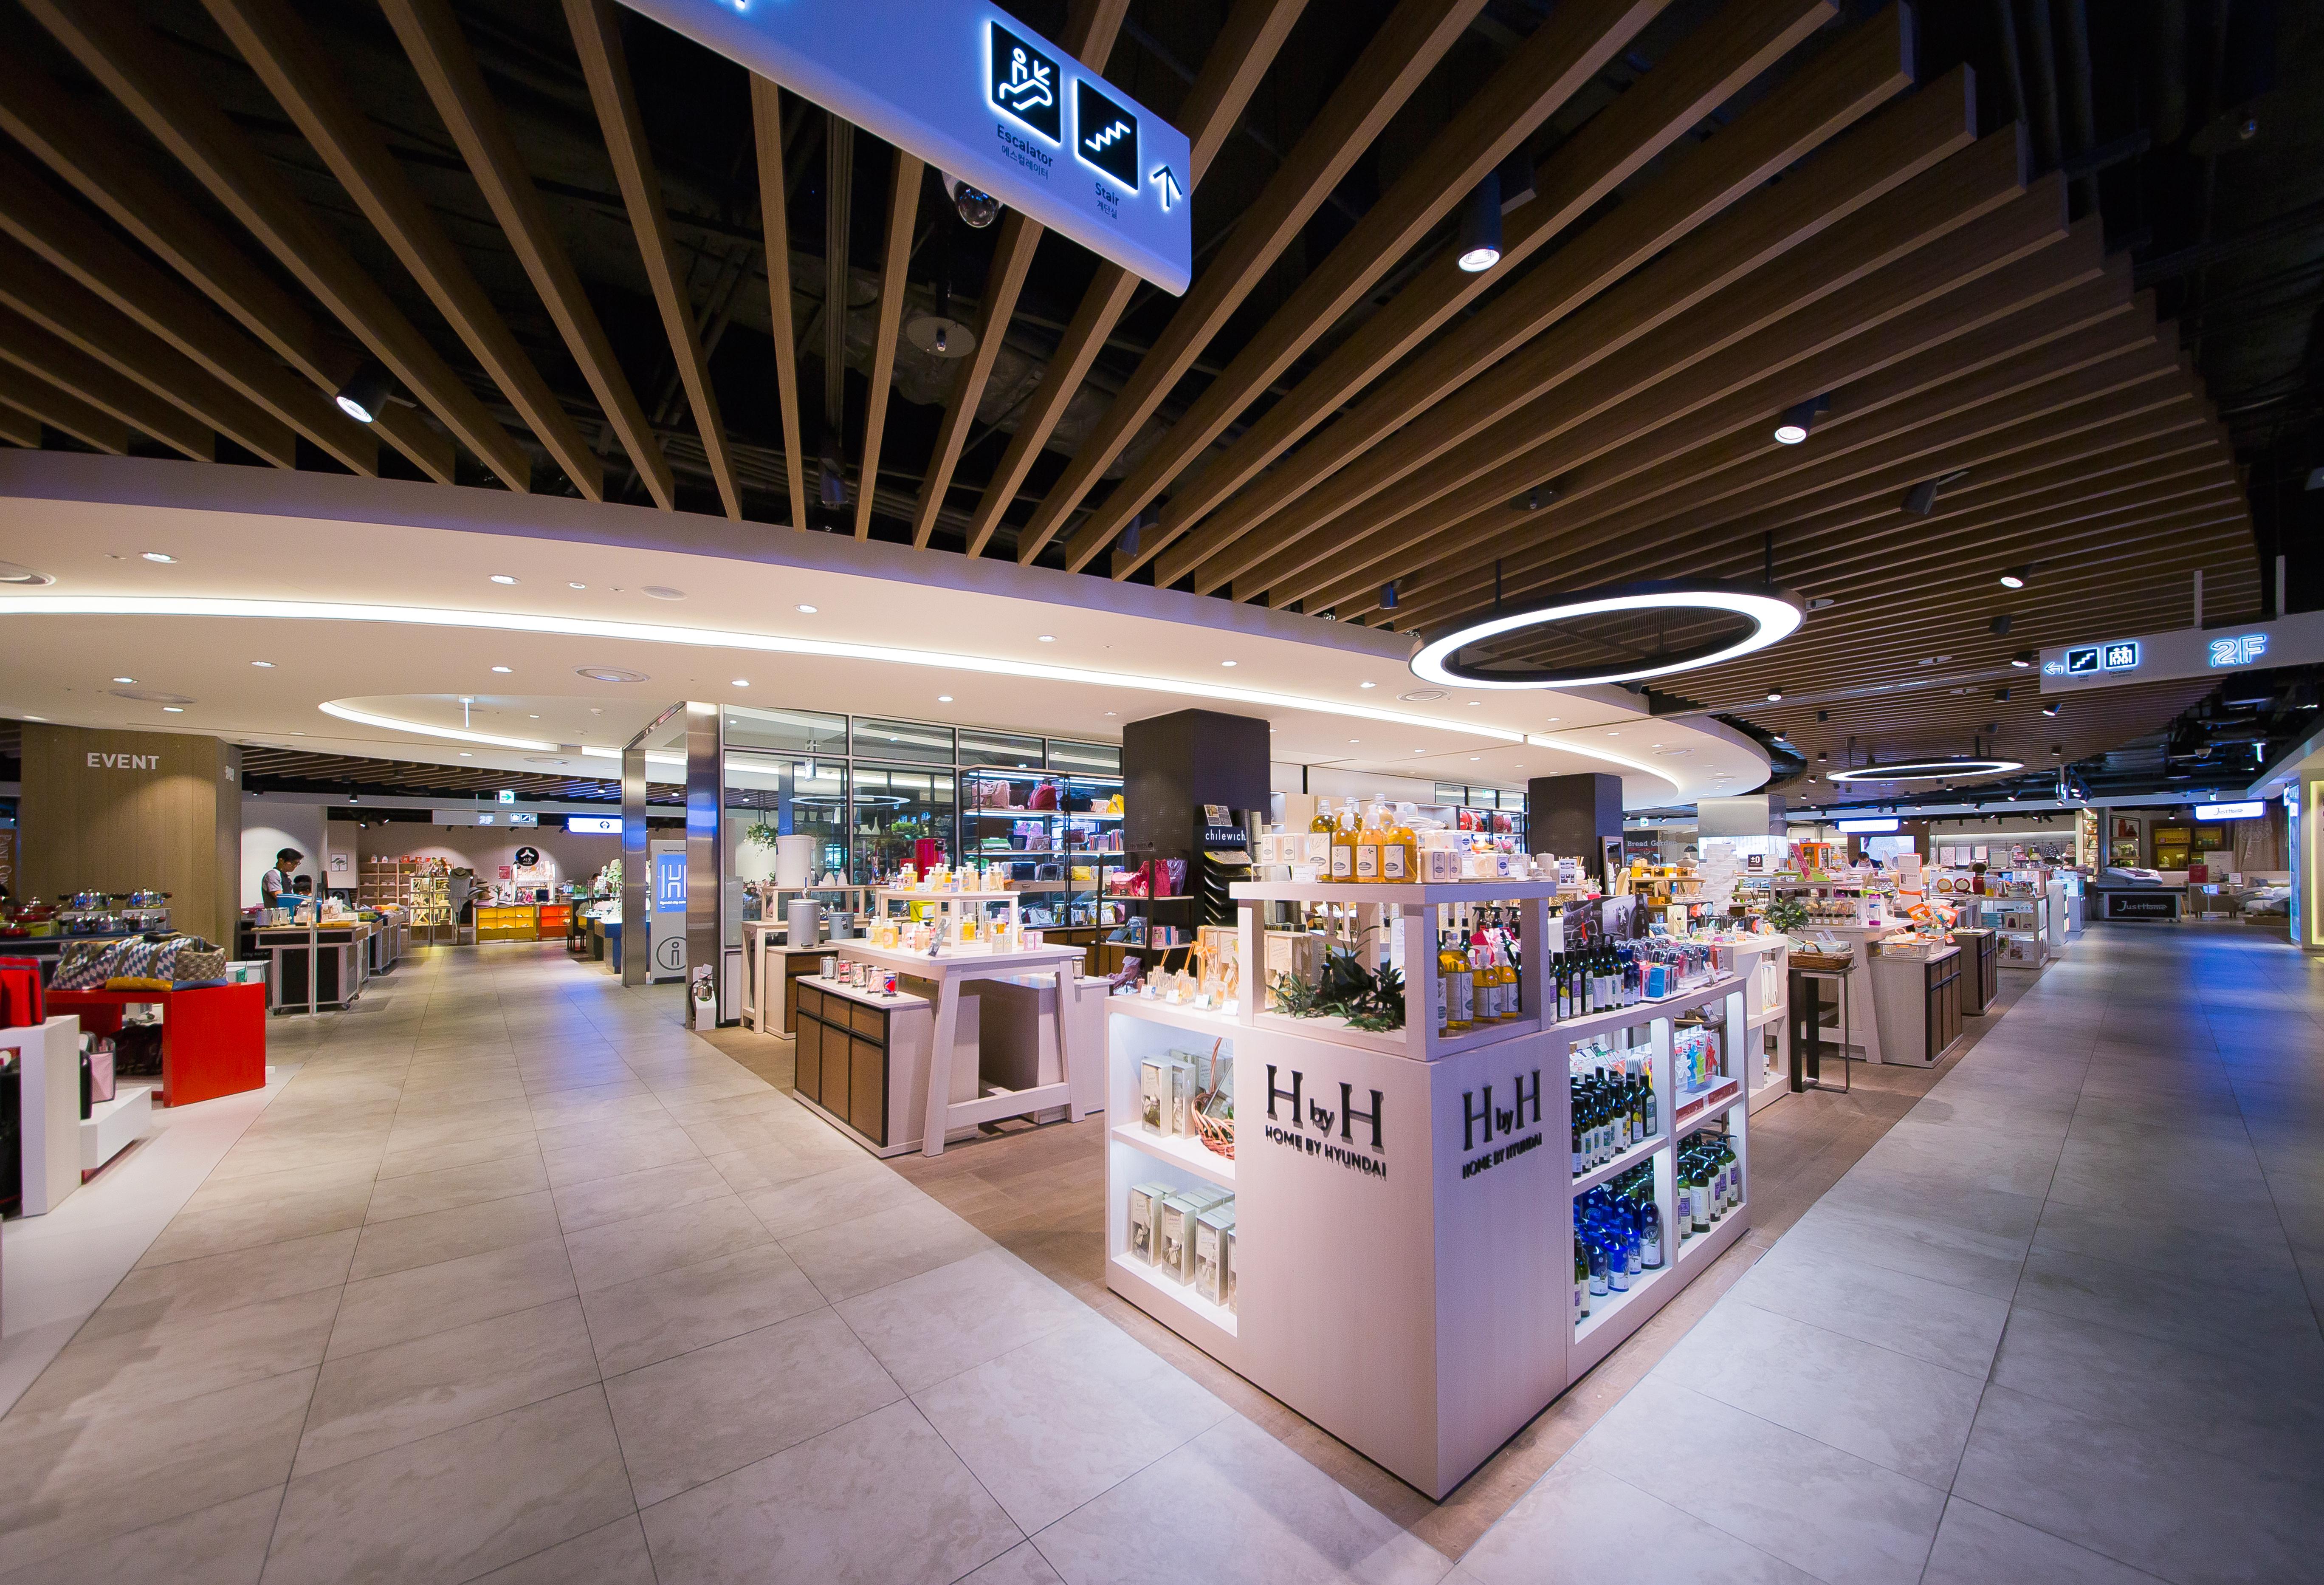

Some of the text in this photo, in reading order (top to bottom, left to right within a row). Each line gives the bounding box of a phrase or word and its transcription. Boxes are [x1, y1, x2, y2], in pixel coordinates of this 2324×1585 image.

[998, 123, 1053, 167] Escalator
[1001, 145, 1048, 179] 에스컬레이터
[1095, 182, 1119, 206] Stair
[1097, 200, 1117, 219] 계단실
[2211, 635, 2266, 667] 2F
[87, 752, 160, 770] EVENT
[479, 815, 494, 825] 2F
[1205, 829, 1246, 841] chilewich
[1266, 1064, 1384, 1150] H by H
[1463, 1069, 1542, 1151] H by H
[1265, 1124, 1387, 1179] HOME BY HYUNDAI
[1462, 1132, 1542, 1179] HOME BY HYUNDAI
